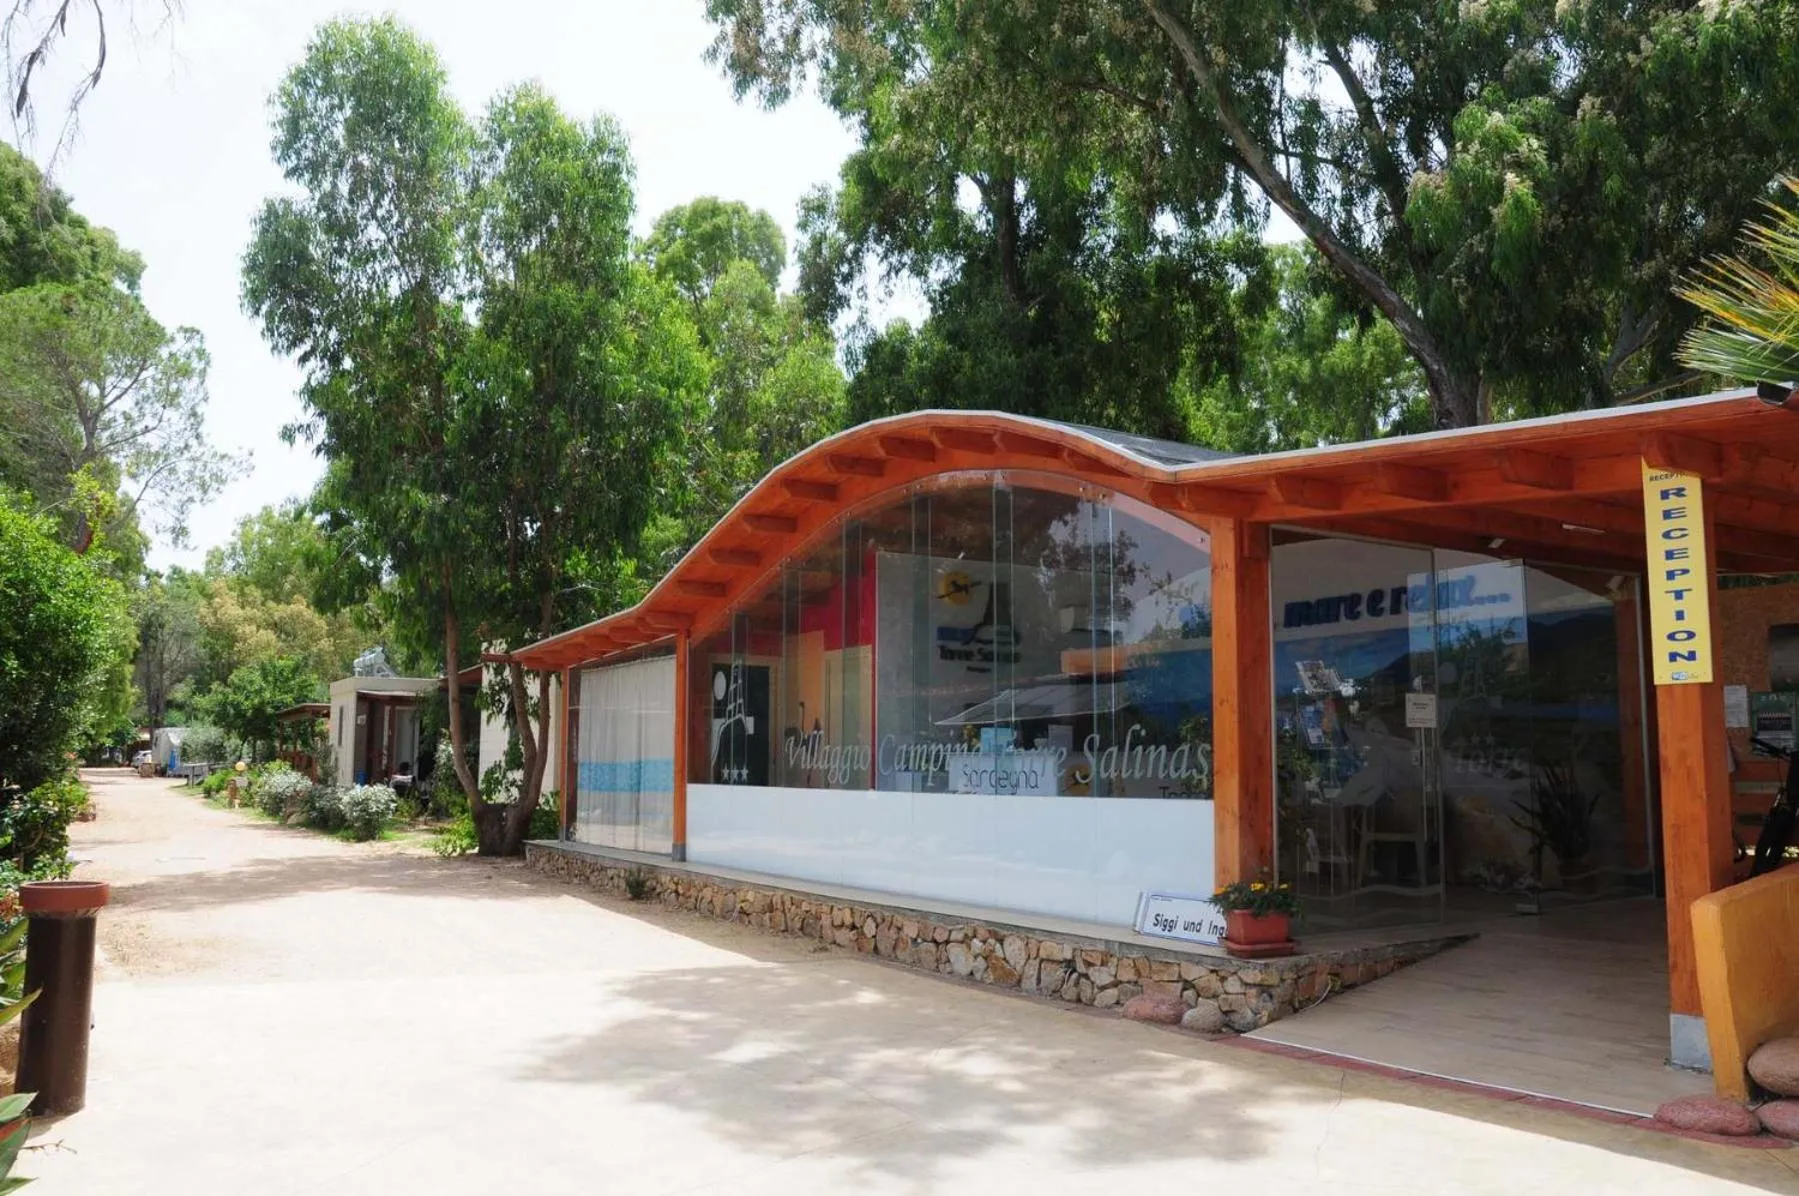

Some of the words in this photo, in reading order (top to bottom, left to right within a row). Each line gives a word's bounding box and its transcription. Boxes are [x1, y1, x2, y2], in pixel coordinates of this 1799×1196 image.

[1660, 486, 1697, 662] RECEPTION
[785, 730, 870, 785] Villaggio
[1075, 724, 1211, 783] Salinas
[1153, 912, 1179, 933] Siggi
[1183, 919, 1203, 933] und
